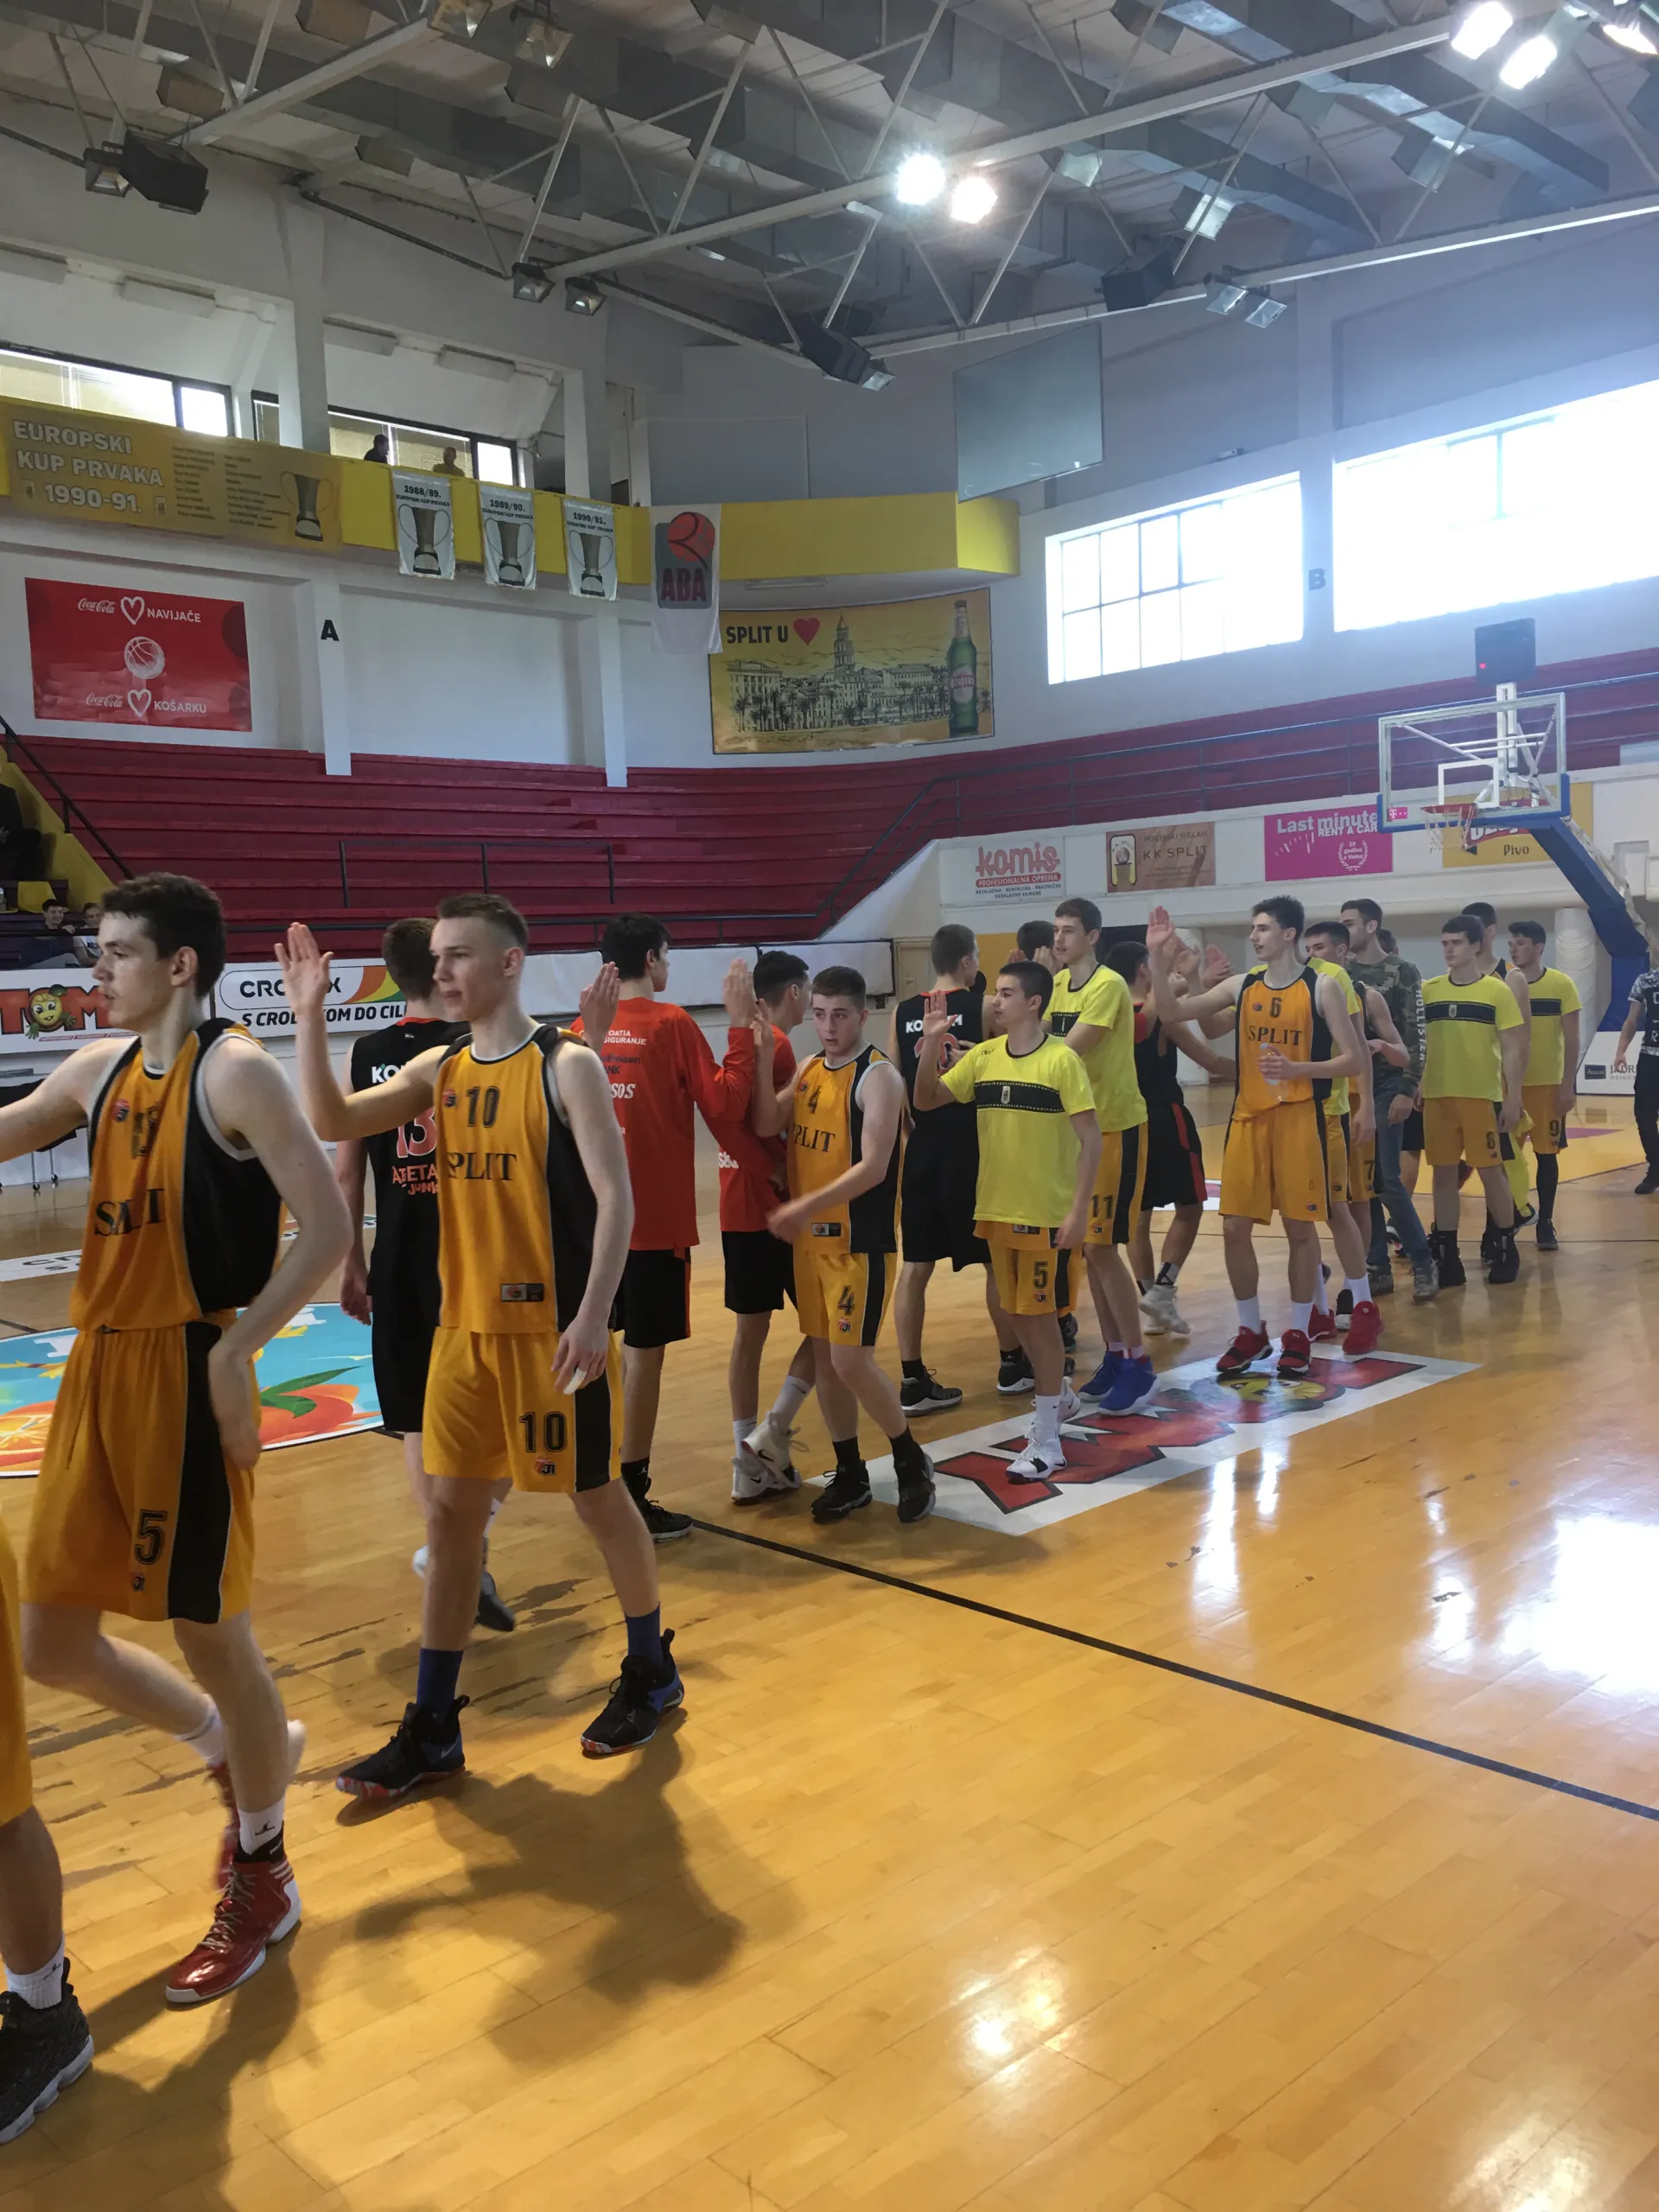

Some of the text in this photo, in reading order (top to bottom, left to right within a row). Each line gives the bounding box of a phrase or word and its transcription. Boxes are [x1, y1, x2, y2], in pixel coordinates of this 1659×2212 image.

[13, 420, 132, 454] EUROPSKI
[17, 449, 164, 487] KUP PRVAKA
[44, 483, 143, 513] 1990-91.
[404, 485, 442, 498] 1988/89.
[489, 499, 525, 512] 1989/90.
[572, 512, 607, 524] 1990/91.
[661, 567, 706, 602] ABA
[1308, 568, 1326, 591] B
[147, 607, 201, 623] NAVIJAČE
[320, 620, 340, 642] A
[726, 625, 789, 645] SPLIT U
[154, 699, 207, 714] KOŠARKU
[1277, 810, 1378, 834] Last minute
[1318, 823, 1378, 837] RENT A CAR
[976, 841, 1061, 878] komis
[1166, 844, 1208, 859] SPLIT
[1503, 844, 1530, 856] Pivo
[978, 874, 1058, 887] PROFESIONALNA OPREMA
[239, 976, 342, 998] CROX
[0, 984, 114, 1036] TOM
[242, 1013, 253, 1027] S
[354, 1006, 377, 1020] DO
[603, 1036, 647, 1046] SIGURANJE
[1248, 1025, 1303, 1046] SPLIT
[467, 1085, 501, 1129] 10
[808, 1085, 822, 1115] 4
[793, 1122, 836, 1154] PLIT
[447, 1152, 518, 1181] PLIT
[1092, 1194, 1114, 1220] 11
[1033, 1261, 1048, 1290] 5
[837, 1285, 855, 1316] 4
[519, 1410, 569, 1453] 10
[134, 1509, 168, 1566] 5
